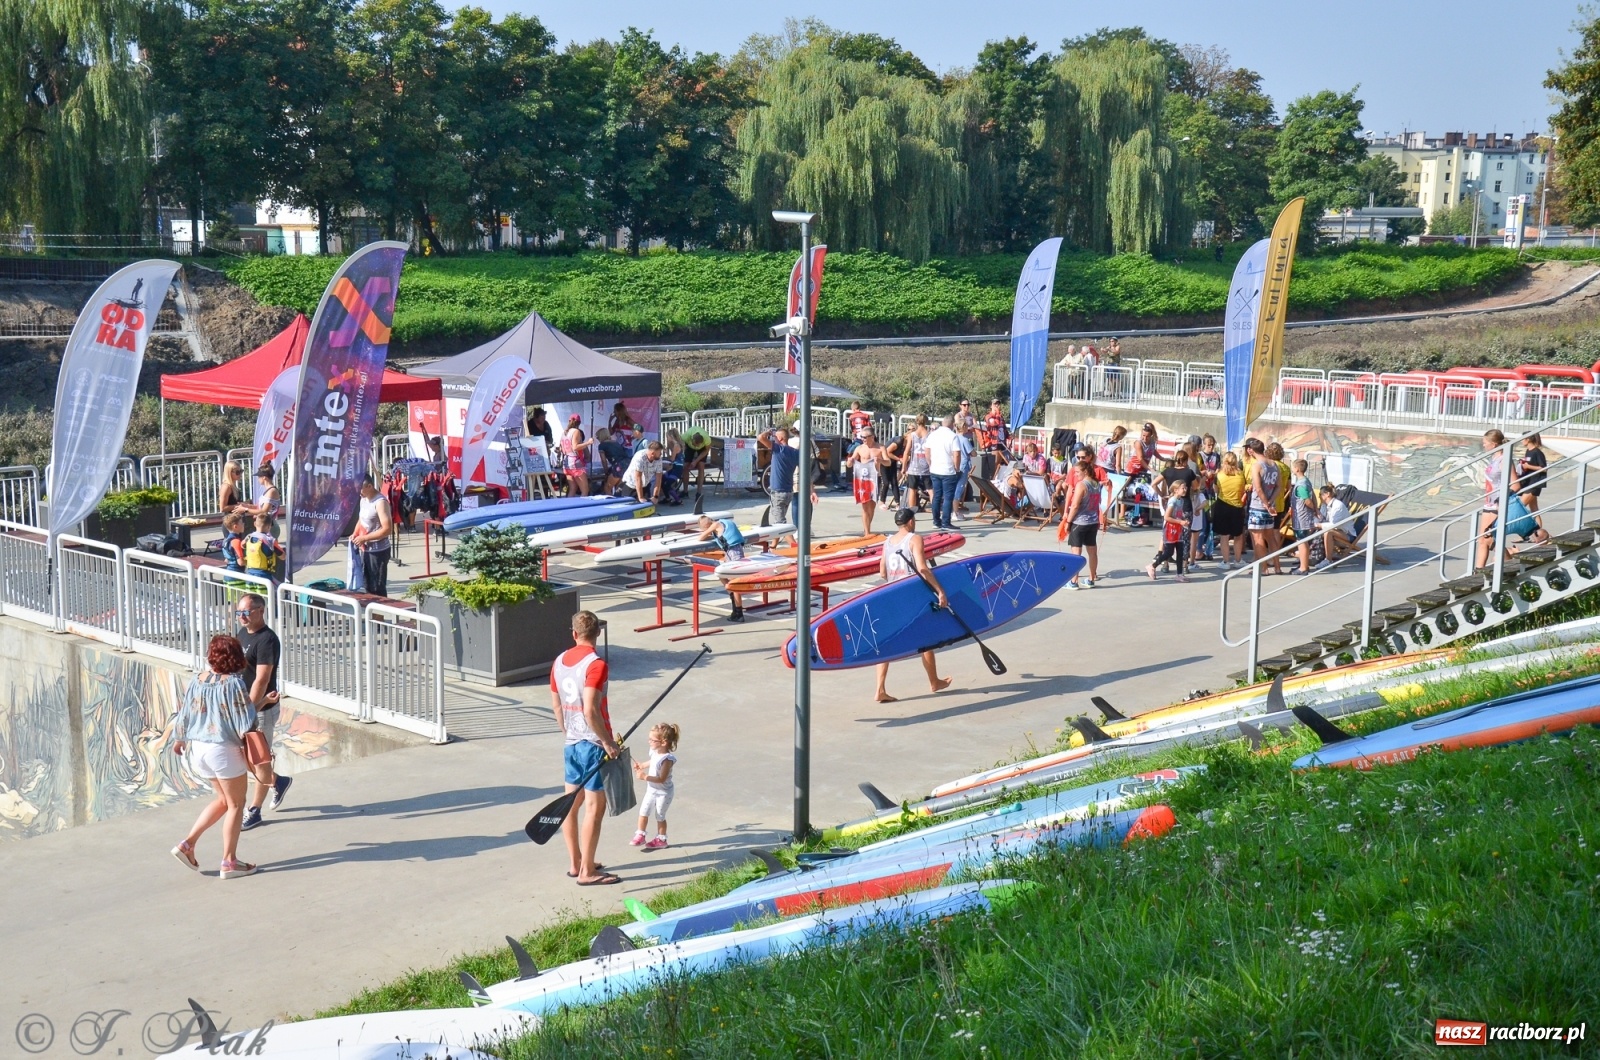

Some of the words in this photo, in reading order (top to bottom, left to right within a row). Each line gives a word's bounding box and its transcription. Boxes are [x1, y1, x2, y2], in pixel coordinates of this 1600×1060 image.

[568, 383, 623, 395] www.raciborz.pl
[482, 367, 527, 427] Edison
[345, 371, 367, 480] www.drukarniaintex.pl
[1263, 471, 1278, 486] 48
[294, 508, 340, 521] #drukarnia
[292, 523, 315, 533] #idea
[561, 677, 578, 704] 9
